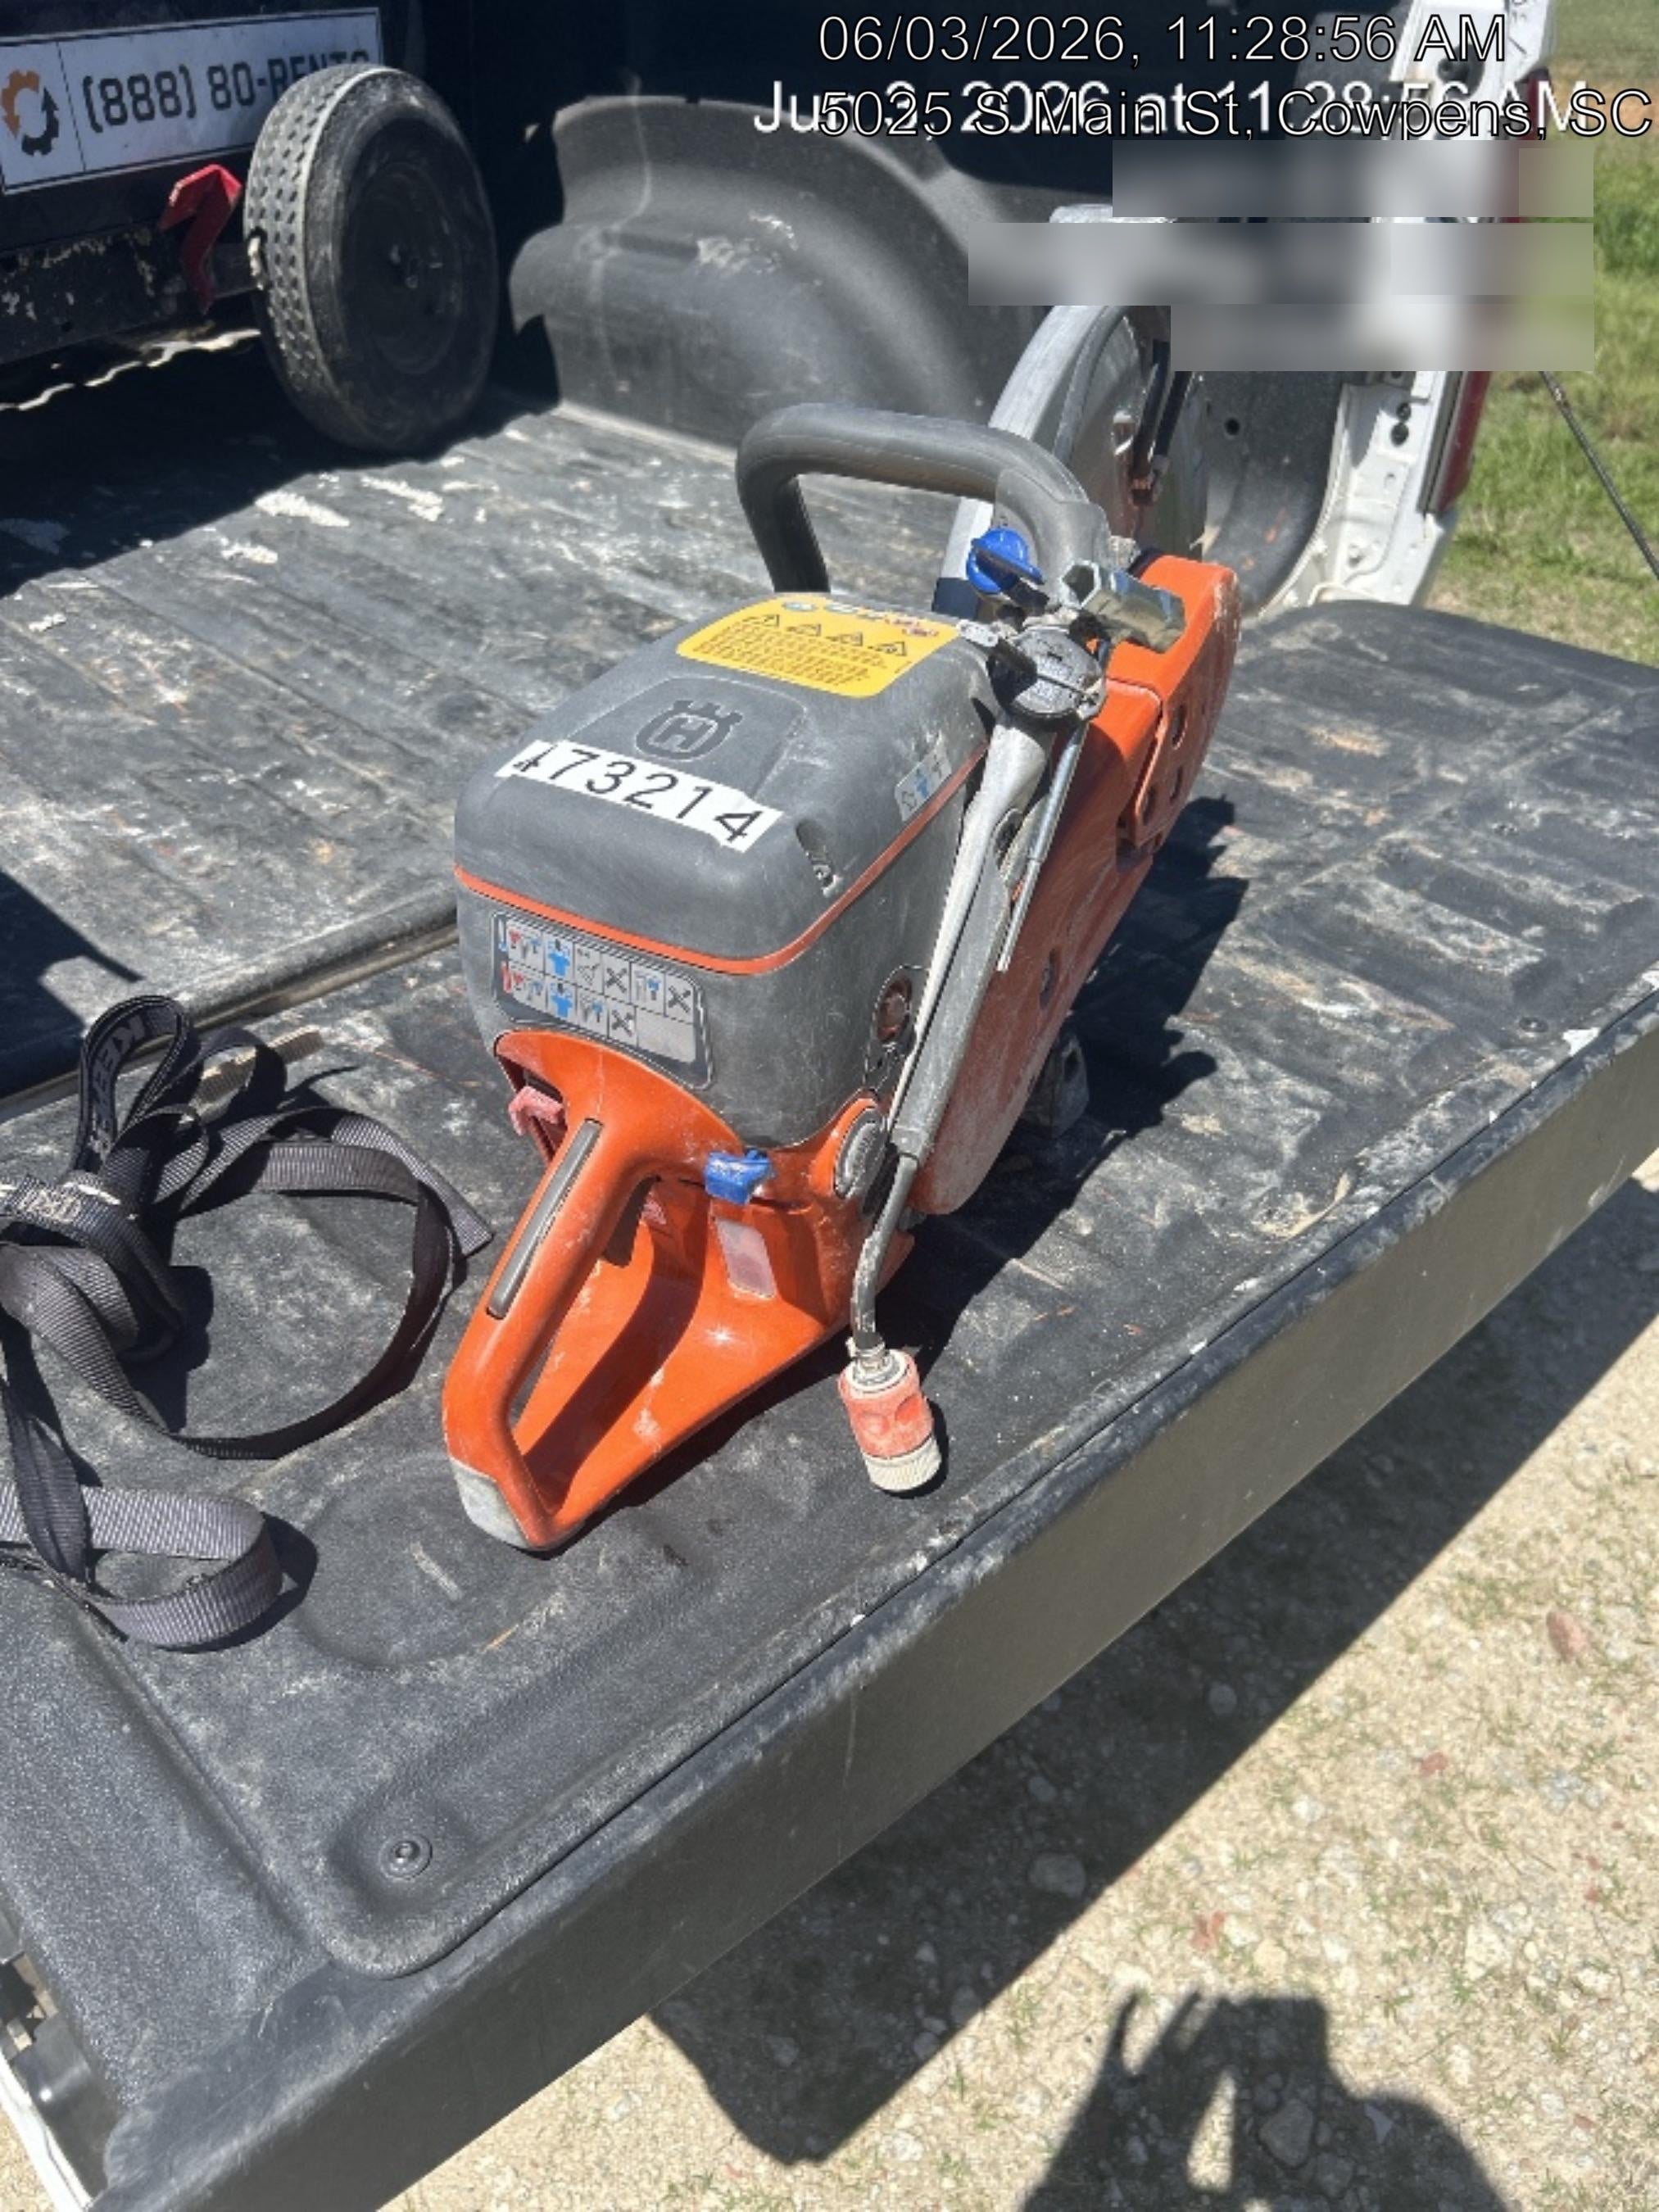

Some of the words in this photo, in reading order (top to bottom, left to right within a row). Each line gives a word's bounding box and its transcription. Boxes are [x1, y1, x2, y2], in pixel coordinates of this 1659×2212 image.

[83, 65, 197, 133] (888)
[207, 49, 369, 111] 80-RE
[512, 744, 764, 842] 473214
